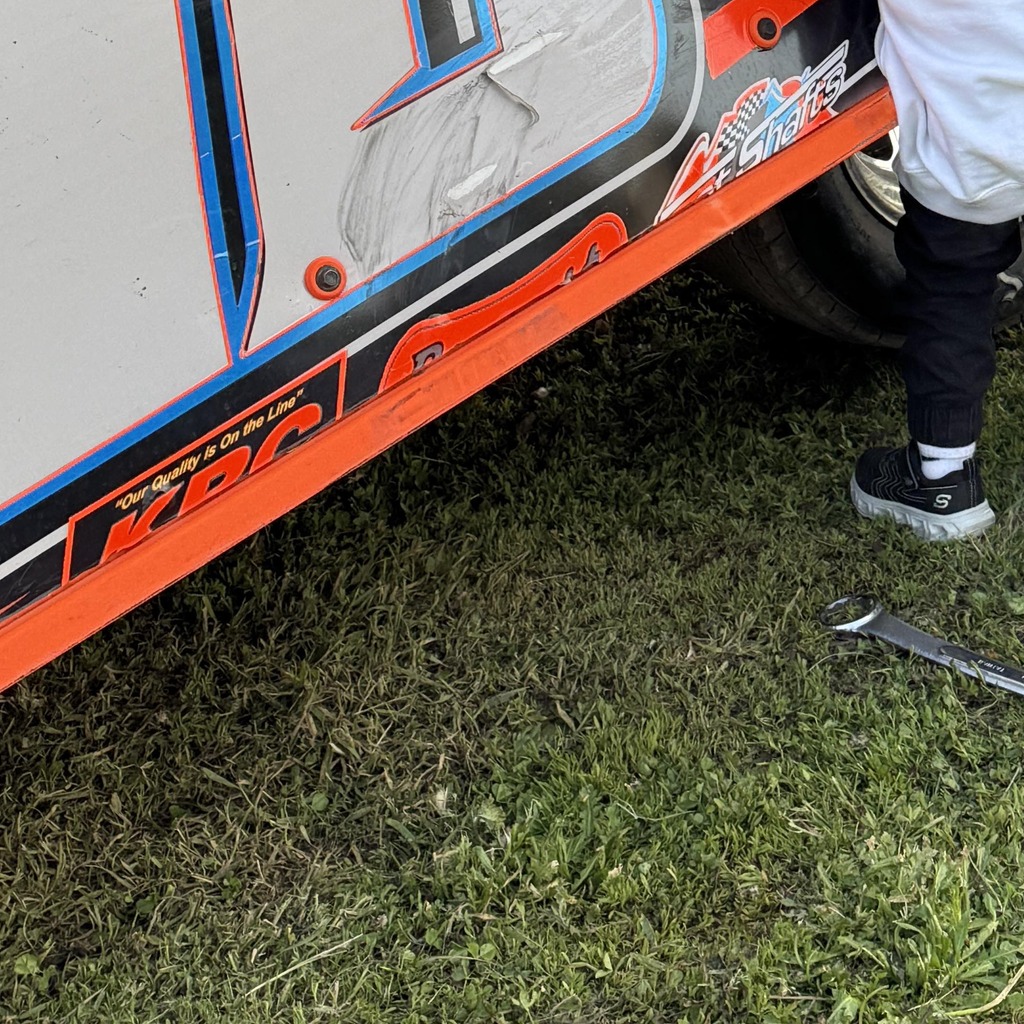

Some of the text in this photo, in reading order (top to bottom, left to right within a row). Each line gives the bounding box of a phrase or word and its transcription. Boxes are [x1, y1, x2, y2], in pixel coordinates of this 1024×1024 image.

[151, 451, 201, 490] Quality
[203, 440, 216, 461] is
[220, 431, 241, 450] On
[242, 417, 264, 437] the
